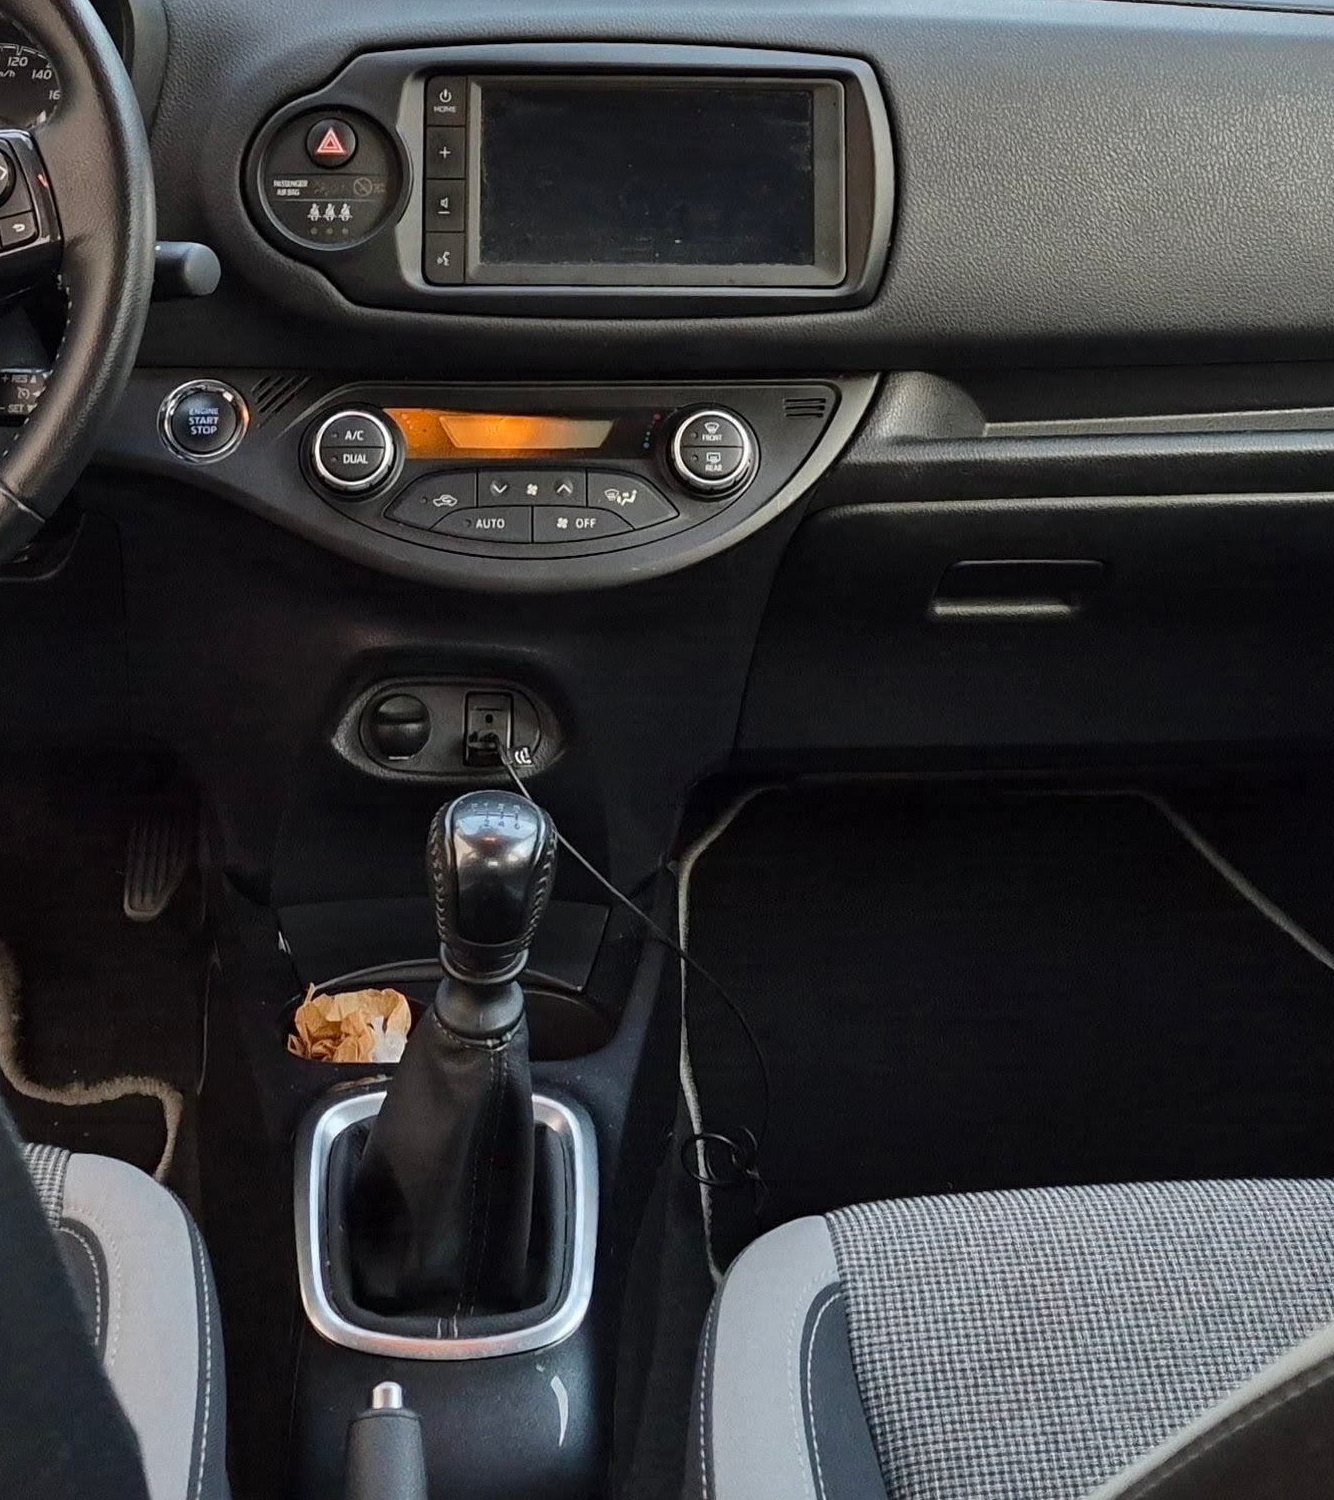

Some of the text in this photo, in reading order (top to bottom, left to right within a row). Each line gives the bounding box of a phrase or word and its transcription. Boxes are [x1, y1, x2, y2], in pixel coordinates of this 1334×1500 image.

[7, 56, 29, 67] 120
[31, 69, 53, 80] 140
[48, 90, 61, 100] 16
[433, 105, 457, 114] HOME
[273, 180, 309, 188] PASSENGER
[276, 188, 301, 196] AIR BAG
[7, 403, 25, 413] SET
[188, 407, 219, 415] ENGINE
[188, 416, 219, 425] START
[190, 425, 218, 435] STOP
[344, 429, 365, 441] A/C
[701, 434, 723, 442] FRONT
[342, 453, 369, 465] DUAL
[705, 463, 723, 472] REAR
[475, 518, 505, 529] AUTO
[575, 518, 597, 529] OFF
